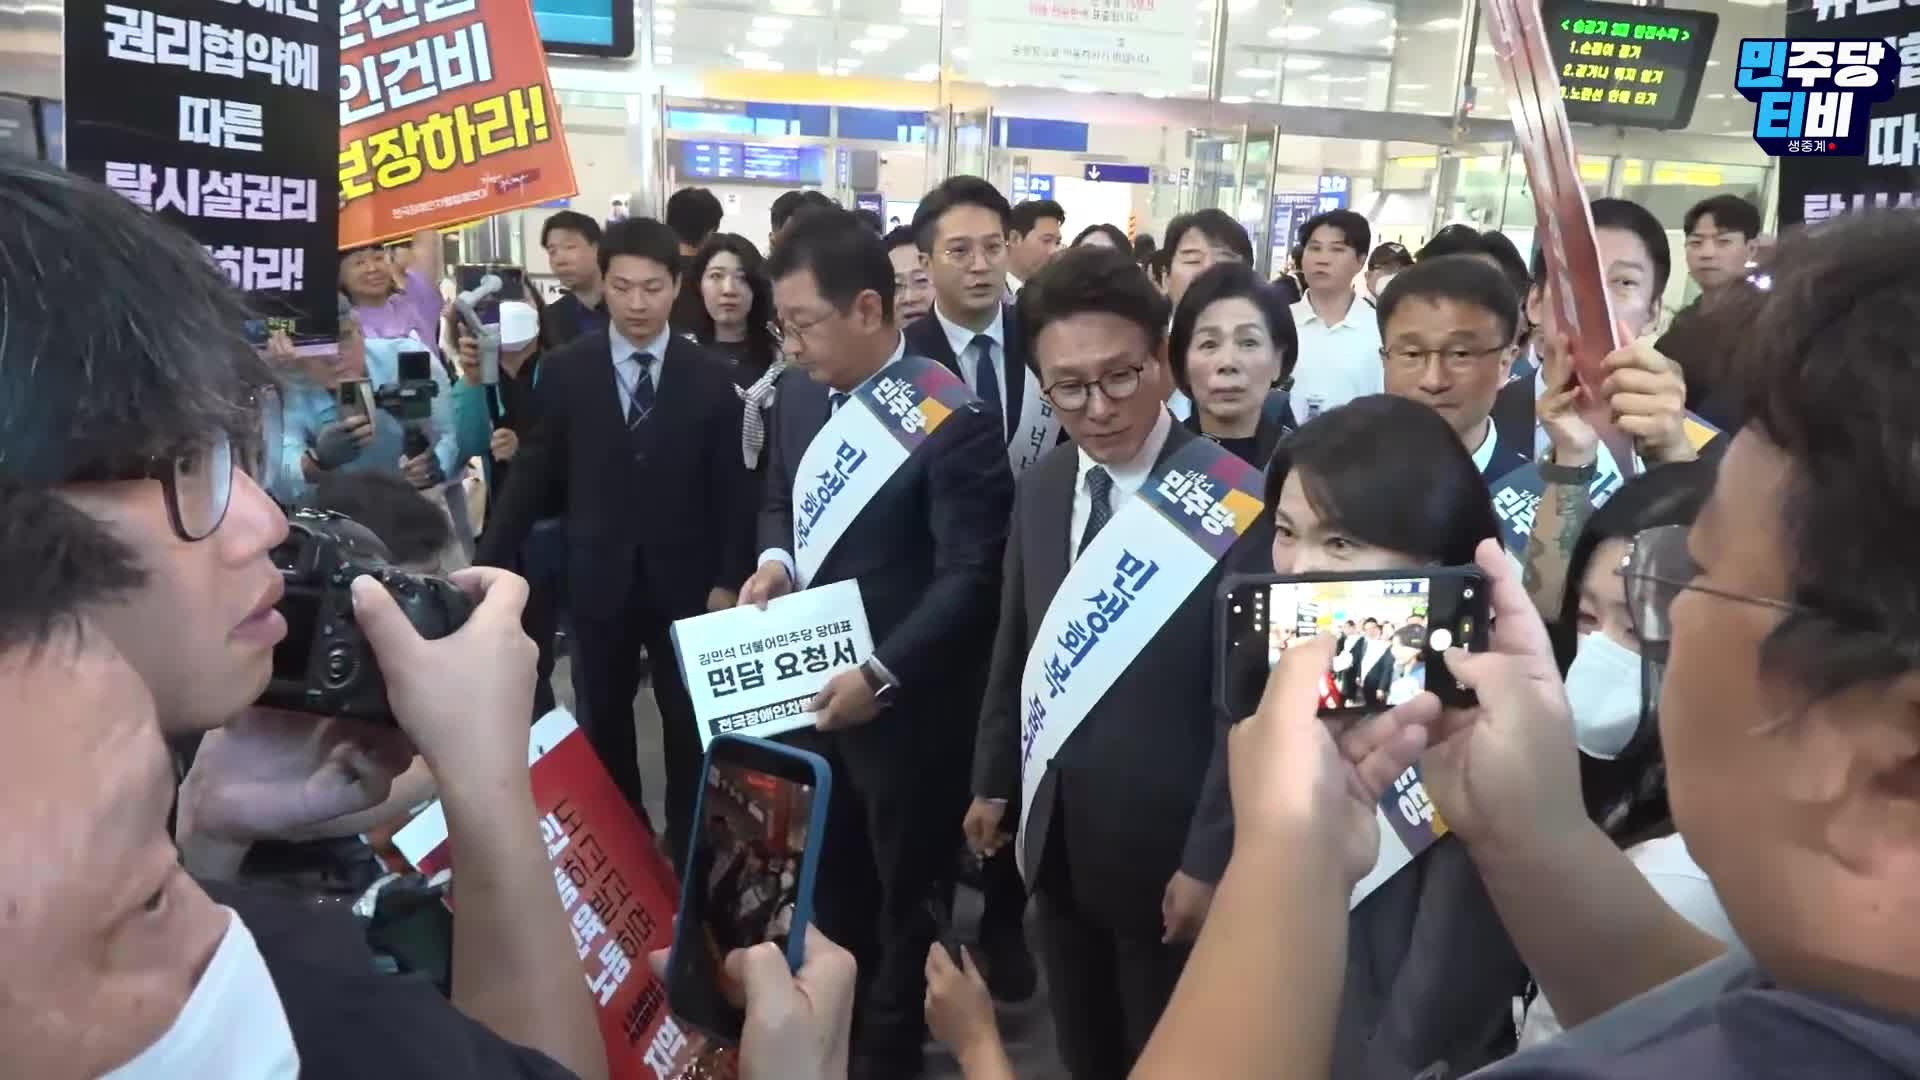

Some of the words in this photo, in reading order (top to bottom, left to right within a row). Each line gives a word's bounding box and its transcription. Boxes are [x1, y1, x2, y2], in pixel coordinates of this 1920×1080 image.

[104, 4, 319, 91] 권리협약에
[339, 22, 493, 127] 인건비
[179, 95, 264, 151] 따른
[339, 85, 549, 199] 보장하라!
[105, 161, 317, 222] 탈시설권리
[201, 245, 304, 292] 하라!
[872, 377, 928, 433] 민주당
[1156, 470, 1236, 535] 민주당
[1493, 486, 1537, 536] 민주
[698, 648, 737, 666] 김민석
[740, 628, 812, 655] 더불어민주당
[815, 619, 853, 638] 당대표
[1044, 548, 1159, 698] 민생회복
[707, 659, 765, 698] 면담
[774, 637, 858, 681] 요청서
[718, 694, 818, 732] 전국장애인차별
